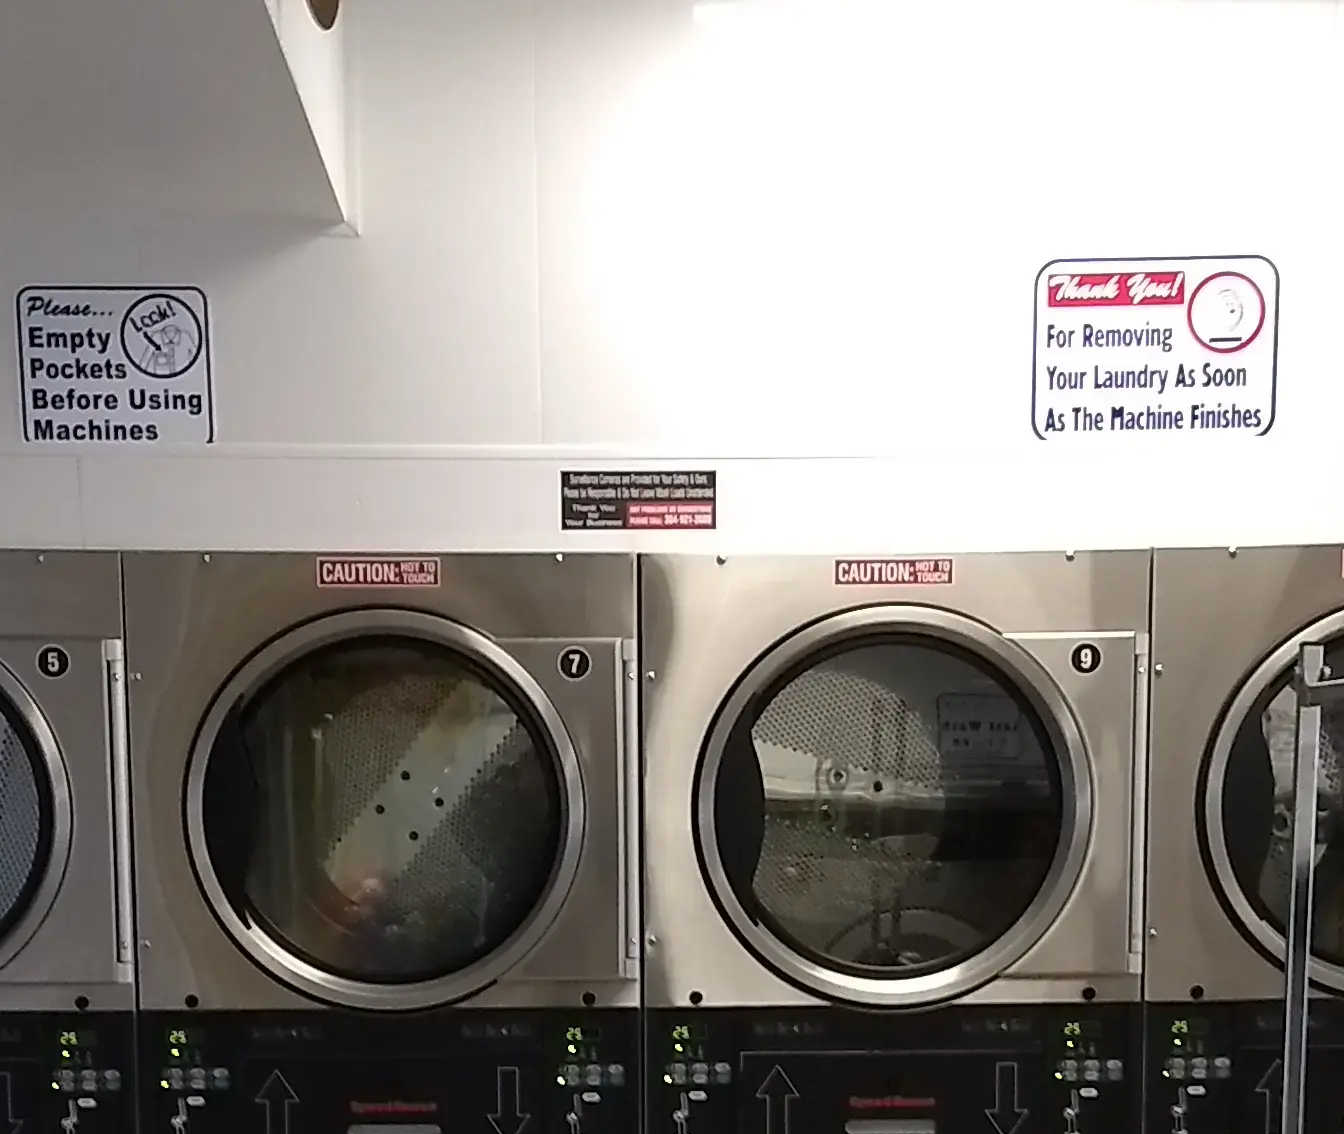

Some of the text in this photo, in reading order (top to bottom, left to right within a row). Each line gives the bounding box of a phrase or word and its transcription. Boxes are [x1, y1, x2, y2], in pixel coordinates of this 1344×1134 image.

[1049, 273, 1184, 305] Thank You!
[26, 296, 113, 317] Please...
[129, 300, 177, 332] Look!
[28, 326, 111, 354] Empty
[1046, 321, 1173, 353] For Removing
[30, 357, 128, 380] Pockets
[1046, 362, 1247, 395] Your Laundry As Soon
[31, 388, 202, 415] Before Using
[1045, 402, 1261, 432] As The Machine Finishes
[33, 419, 159, 441] Machines
[322, 563, 399, 582] CAUTION:
[838, 563, 914, 583] CAUTION:
[48, 651, 59, 672] 5
[569, 654, 581, 674] 7
[1080, 649, 1092, 669] 9
